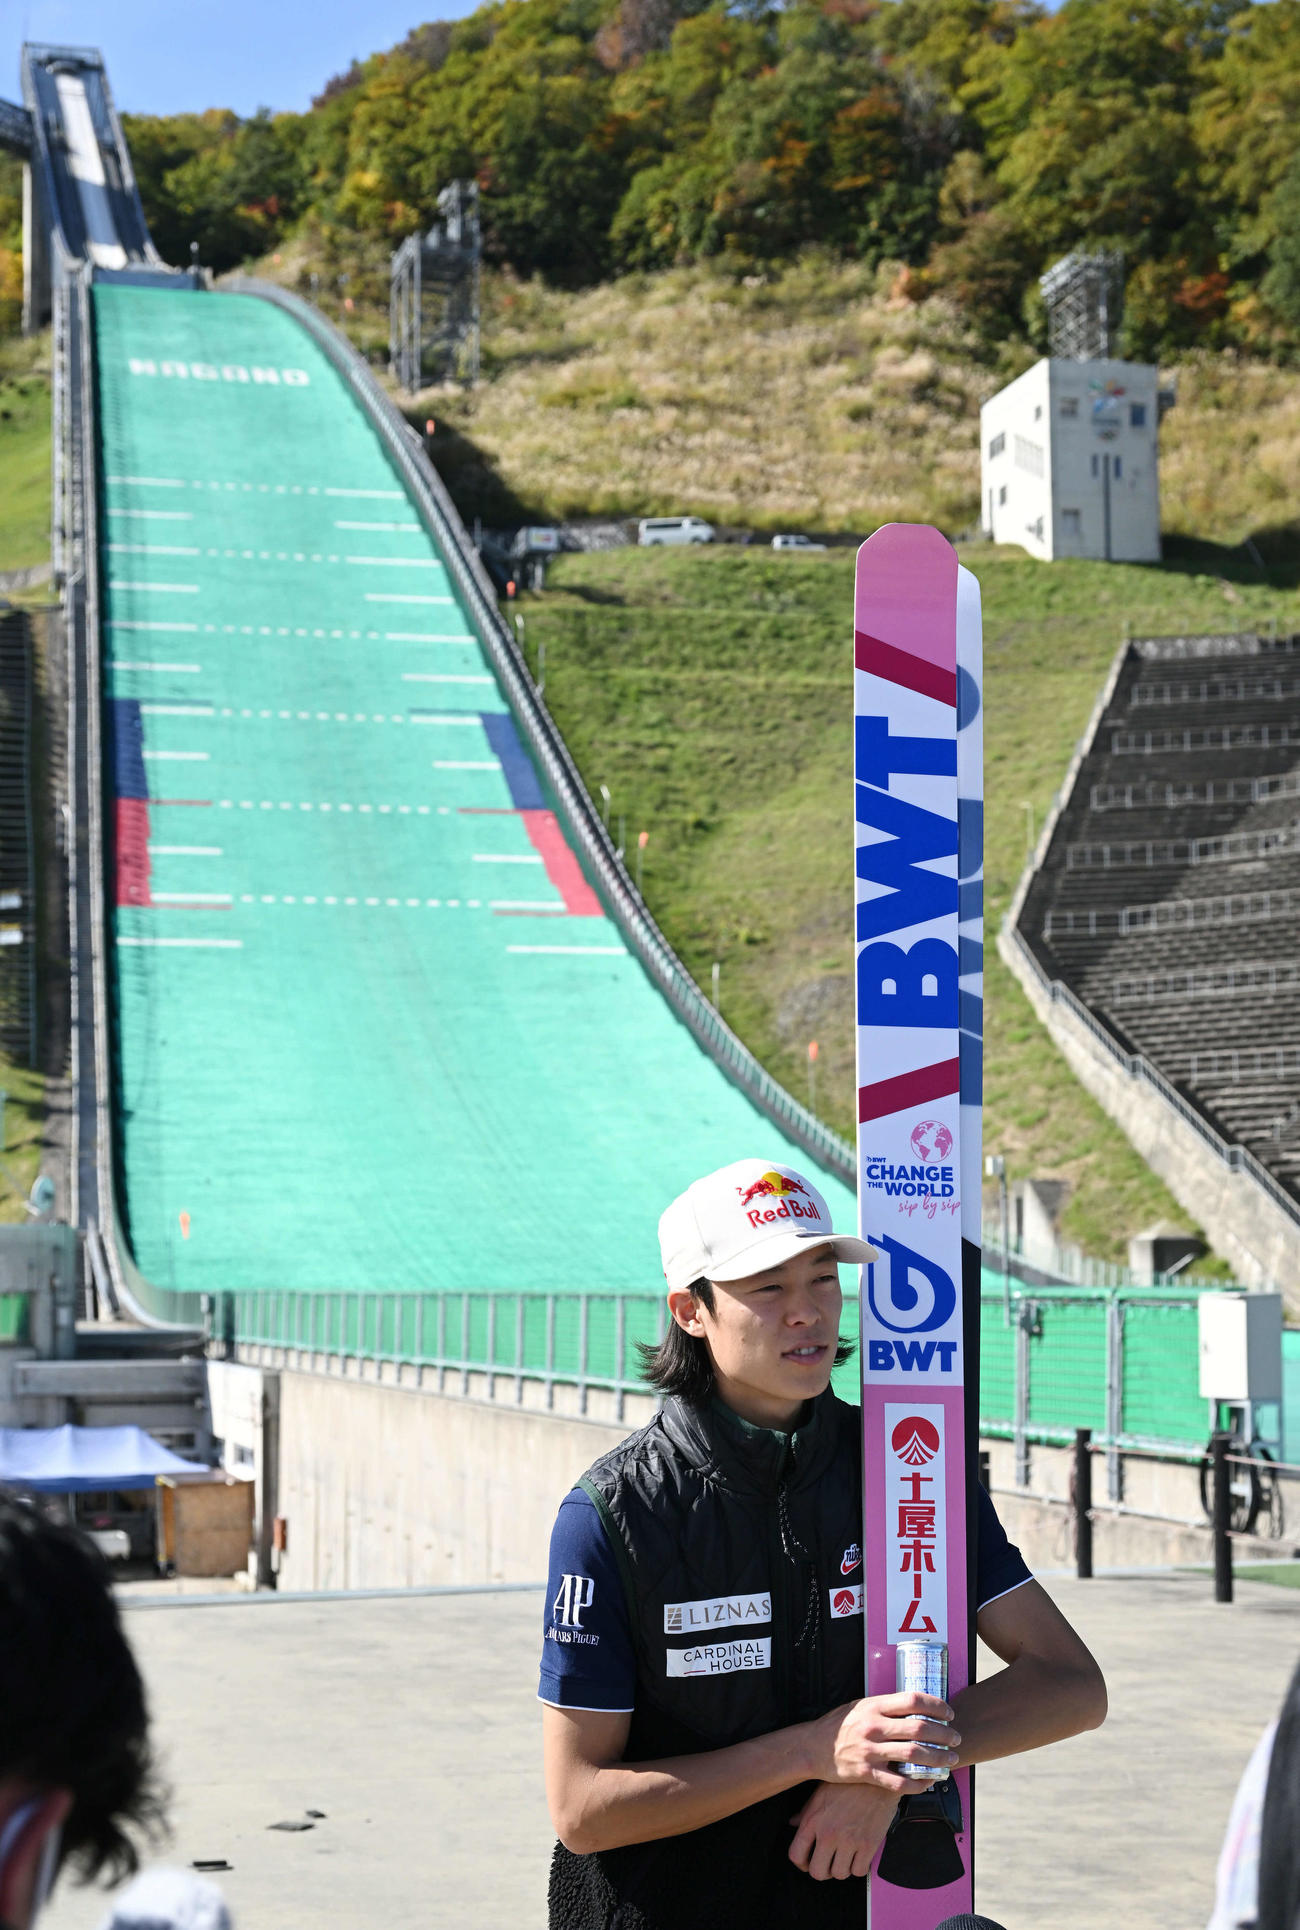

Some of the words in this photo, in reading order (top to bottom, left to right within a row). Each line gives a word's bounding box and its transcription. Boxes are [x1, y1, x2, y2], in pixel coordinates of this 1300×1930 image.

[855, 715, 959, 1029] BWT
[866, 1164, 954, 1182] CHANGE
[867, 1181, 884, 1189] THE
[884, 1182, 955, 1197] WORLD
[746, 1199, 791, 1229] Red
[788, 1199, 821, 1220] Bull
[898, 1200, 918, 1218] sip
[923, 1191, 937, 1219] by
[941, 1198, 961, 1216] sip
[868, 1340, 957, 1372] BWT
[897, 1472, 938, 1633] 土屋ホーム
[553, 1574, 595, 1628] AP
[689, 1599, 771, 1625] LIZNAS
[683, 1641, 764, 1662] CARDINAL
[710, 1654, 765, 1672] HOUSE
